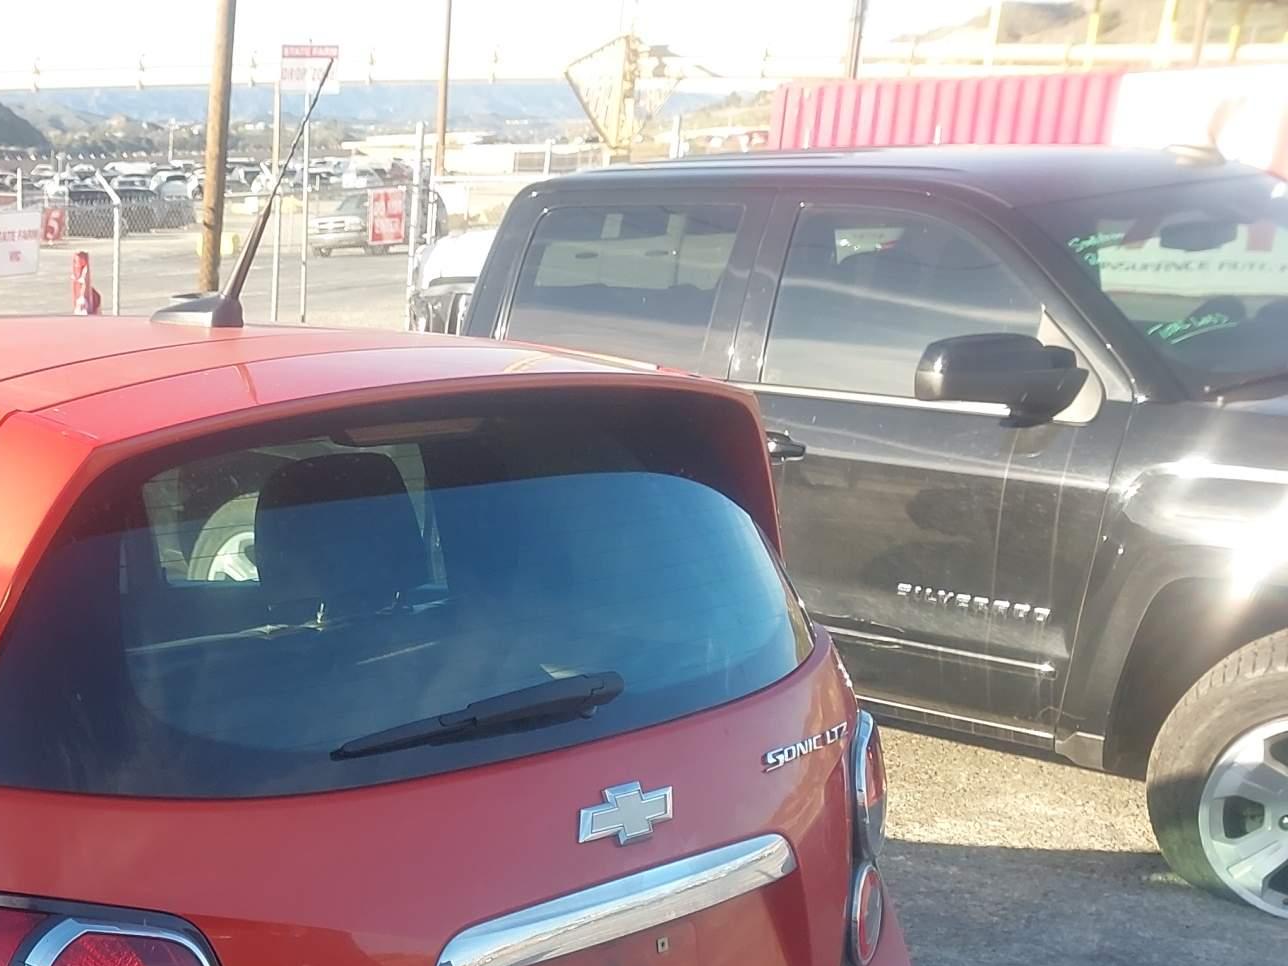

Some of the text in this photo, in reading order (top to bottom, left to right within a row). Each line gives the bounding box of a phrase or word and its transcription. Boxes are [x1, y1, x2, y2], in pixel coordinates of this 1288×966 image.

[312, 67, 335, 80] ZOE
[46, 210, 60, 240] 5
[762, 721, 849, 773] SONIC LTZ
